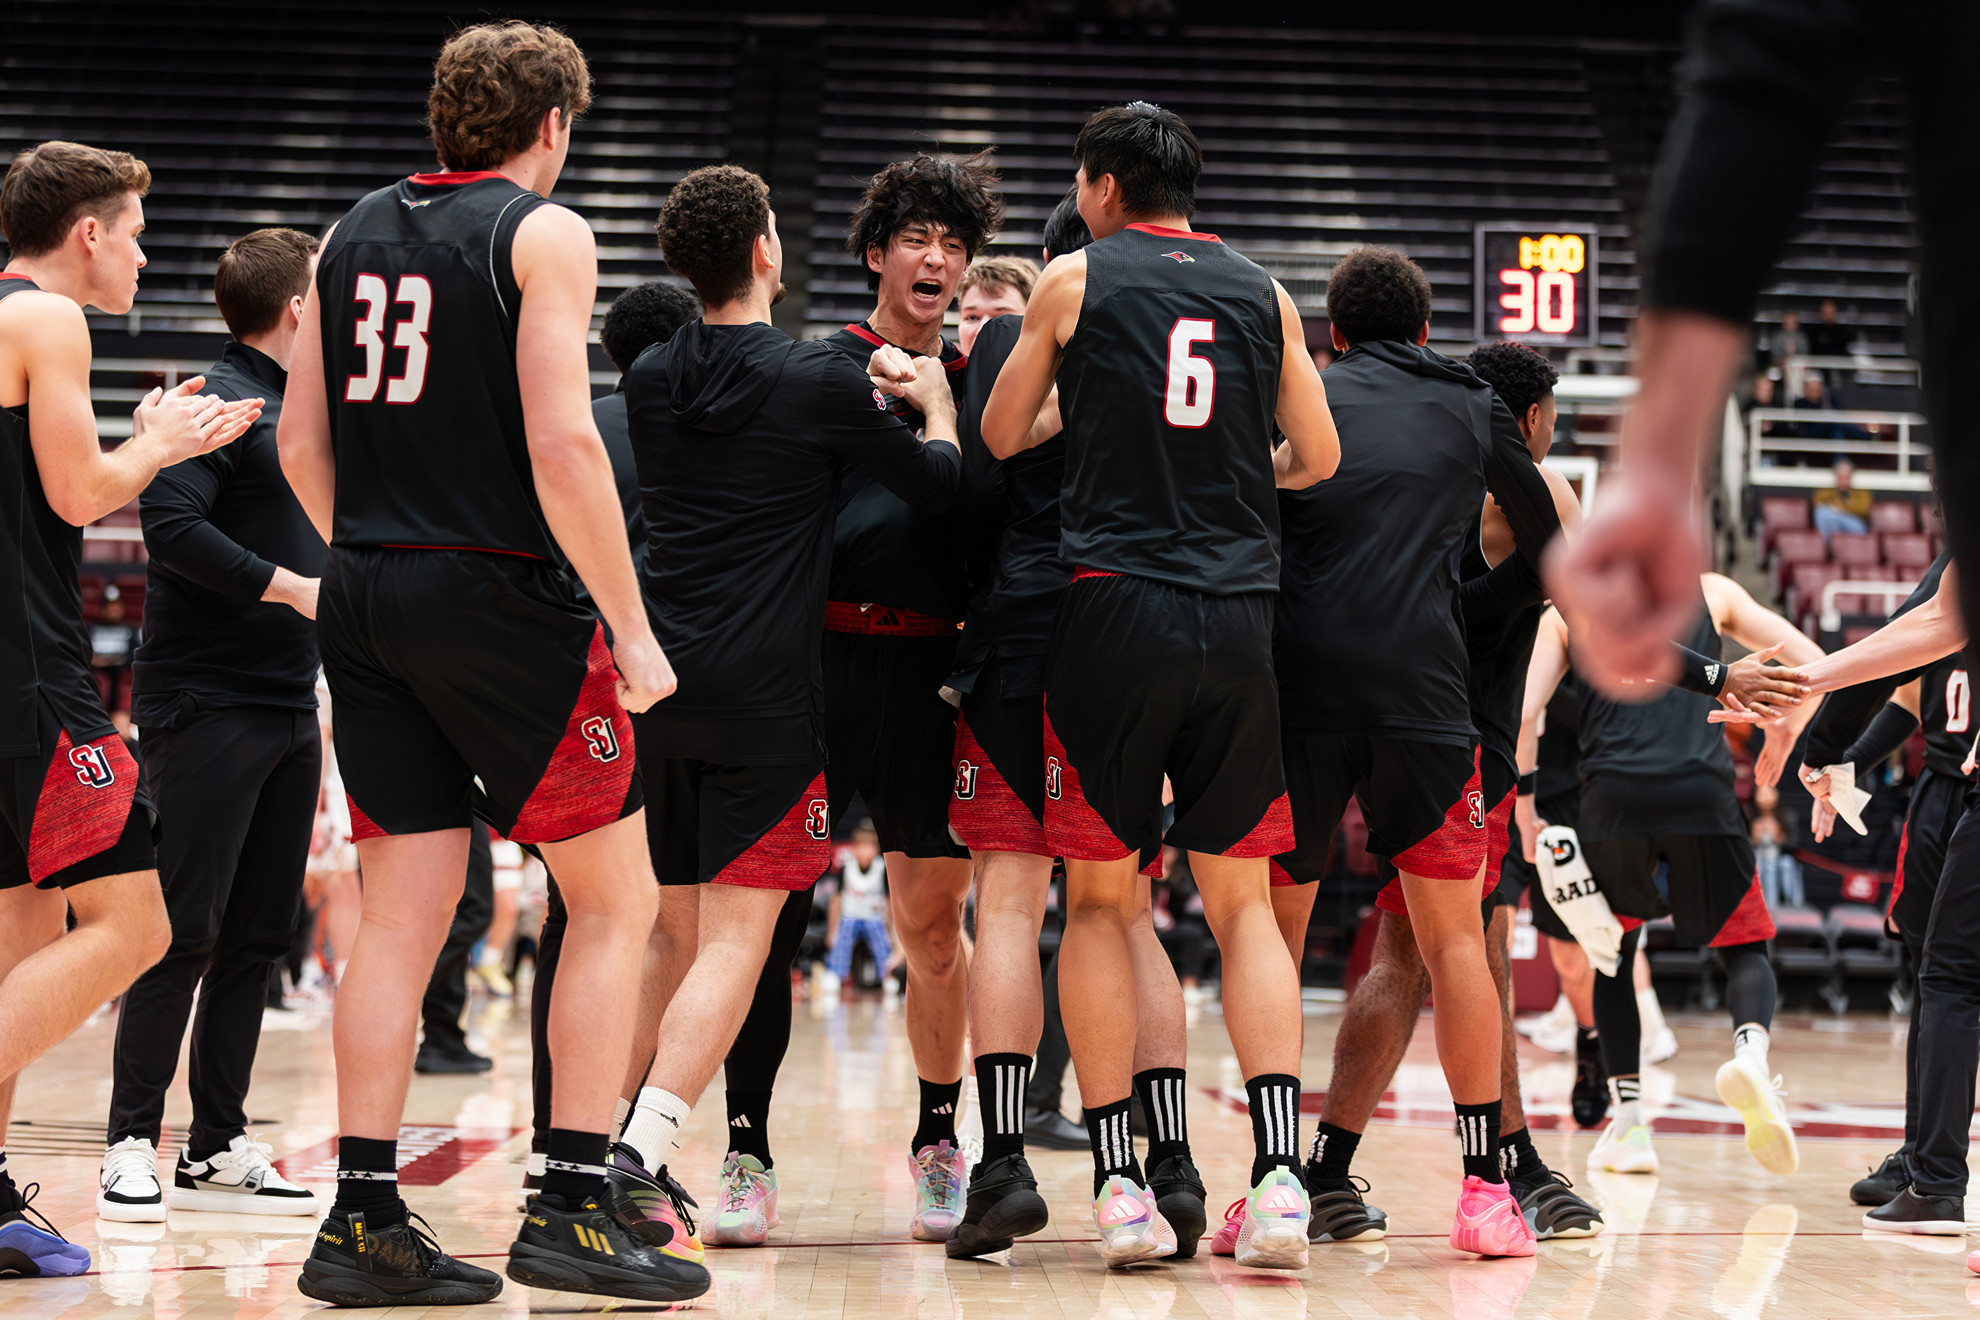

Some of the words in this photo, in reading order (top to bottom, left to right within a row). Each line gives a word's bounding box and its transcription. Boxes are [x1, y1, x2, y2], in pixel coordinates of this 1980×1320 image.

[1519, 234, 1585, 273] 1:00
[344, 272, 434, 405] 33
[1498, 269, 1576, 333] 30
[1163, 316, 1216, 429] 6
